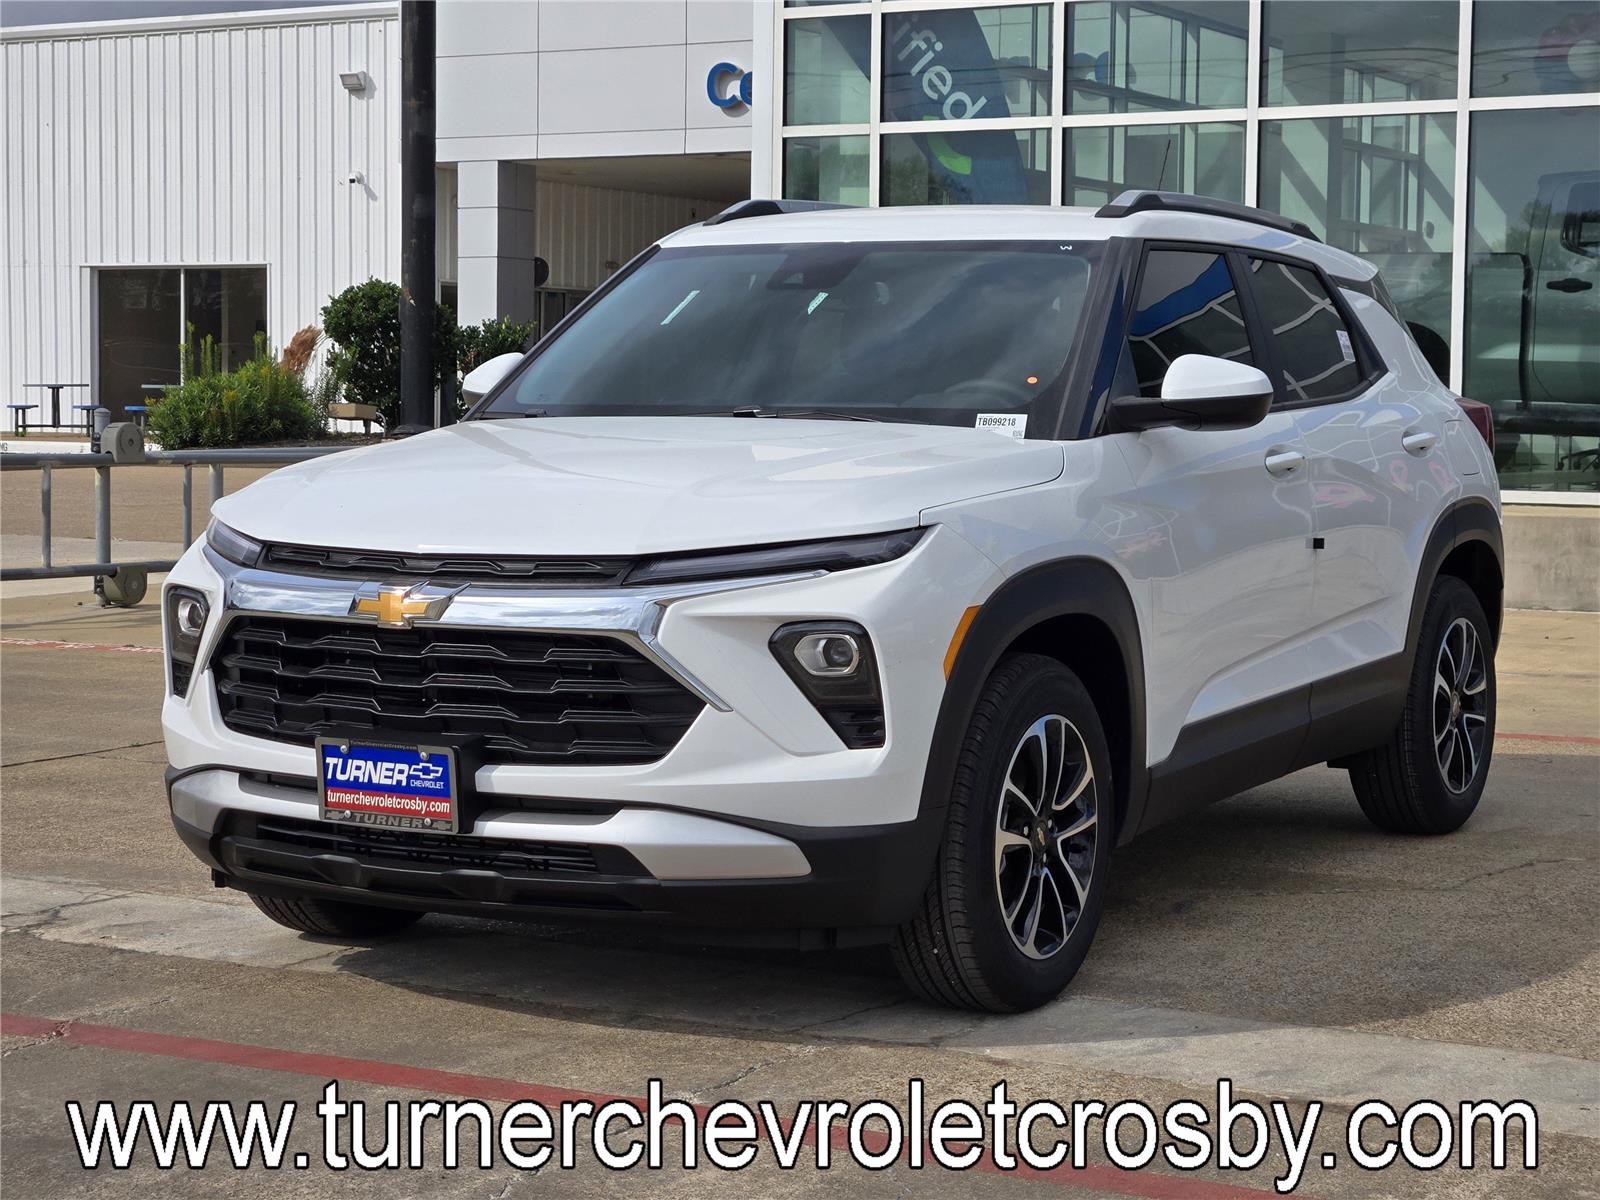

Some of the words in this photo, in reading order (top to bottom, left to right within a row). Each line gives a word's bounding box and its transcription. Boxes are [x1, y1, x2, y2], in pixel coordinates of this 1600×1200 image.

[978, 417, 1017, 427] TB099218
[325, 756, 410, 787] TURNER
[410, 779, 445, 789] CHEVROLET
[327, 789, 450, 814] turnerchevroletcrosby.com
[354, 813, 423, 829] TURNER
